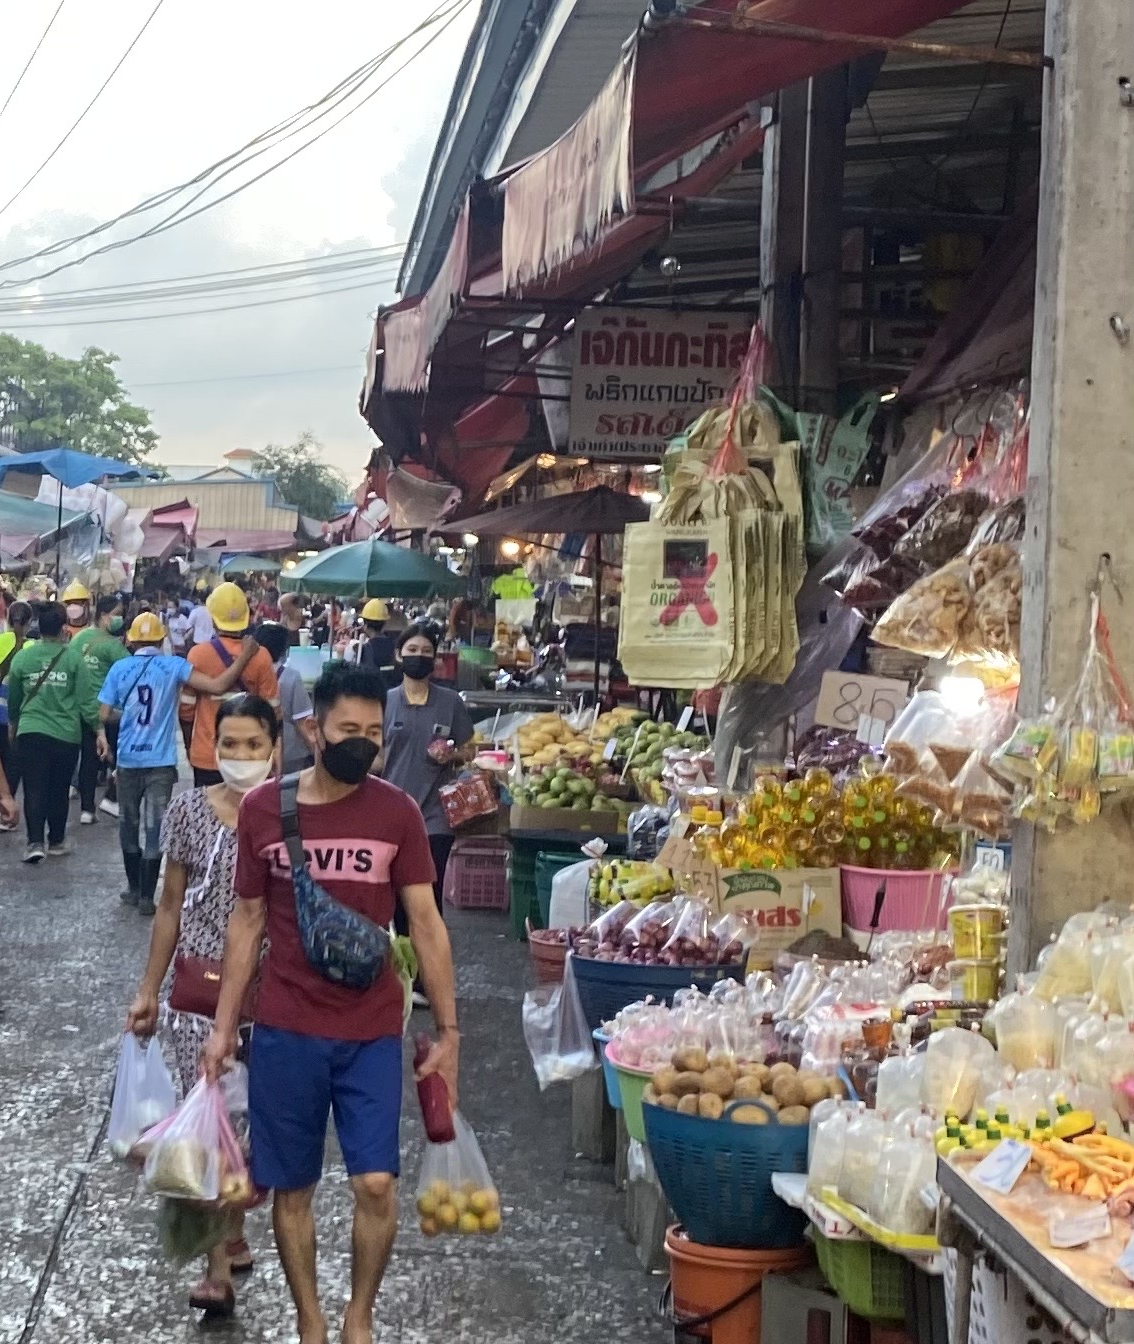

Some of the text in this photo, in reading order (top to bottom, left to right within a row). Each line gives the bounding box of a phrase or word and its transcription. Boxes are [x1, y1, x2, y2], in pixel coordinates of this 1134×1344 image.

[585, 375, 726, 403] พริกแกงปัก
[595, 407, 690, 436] รสเด็
[137, 684, 153, 727] 9
